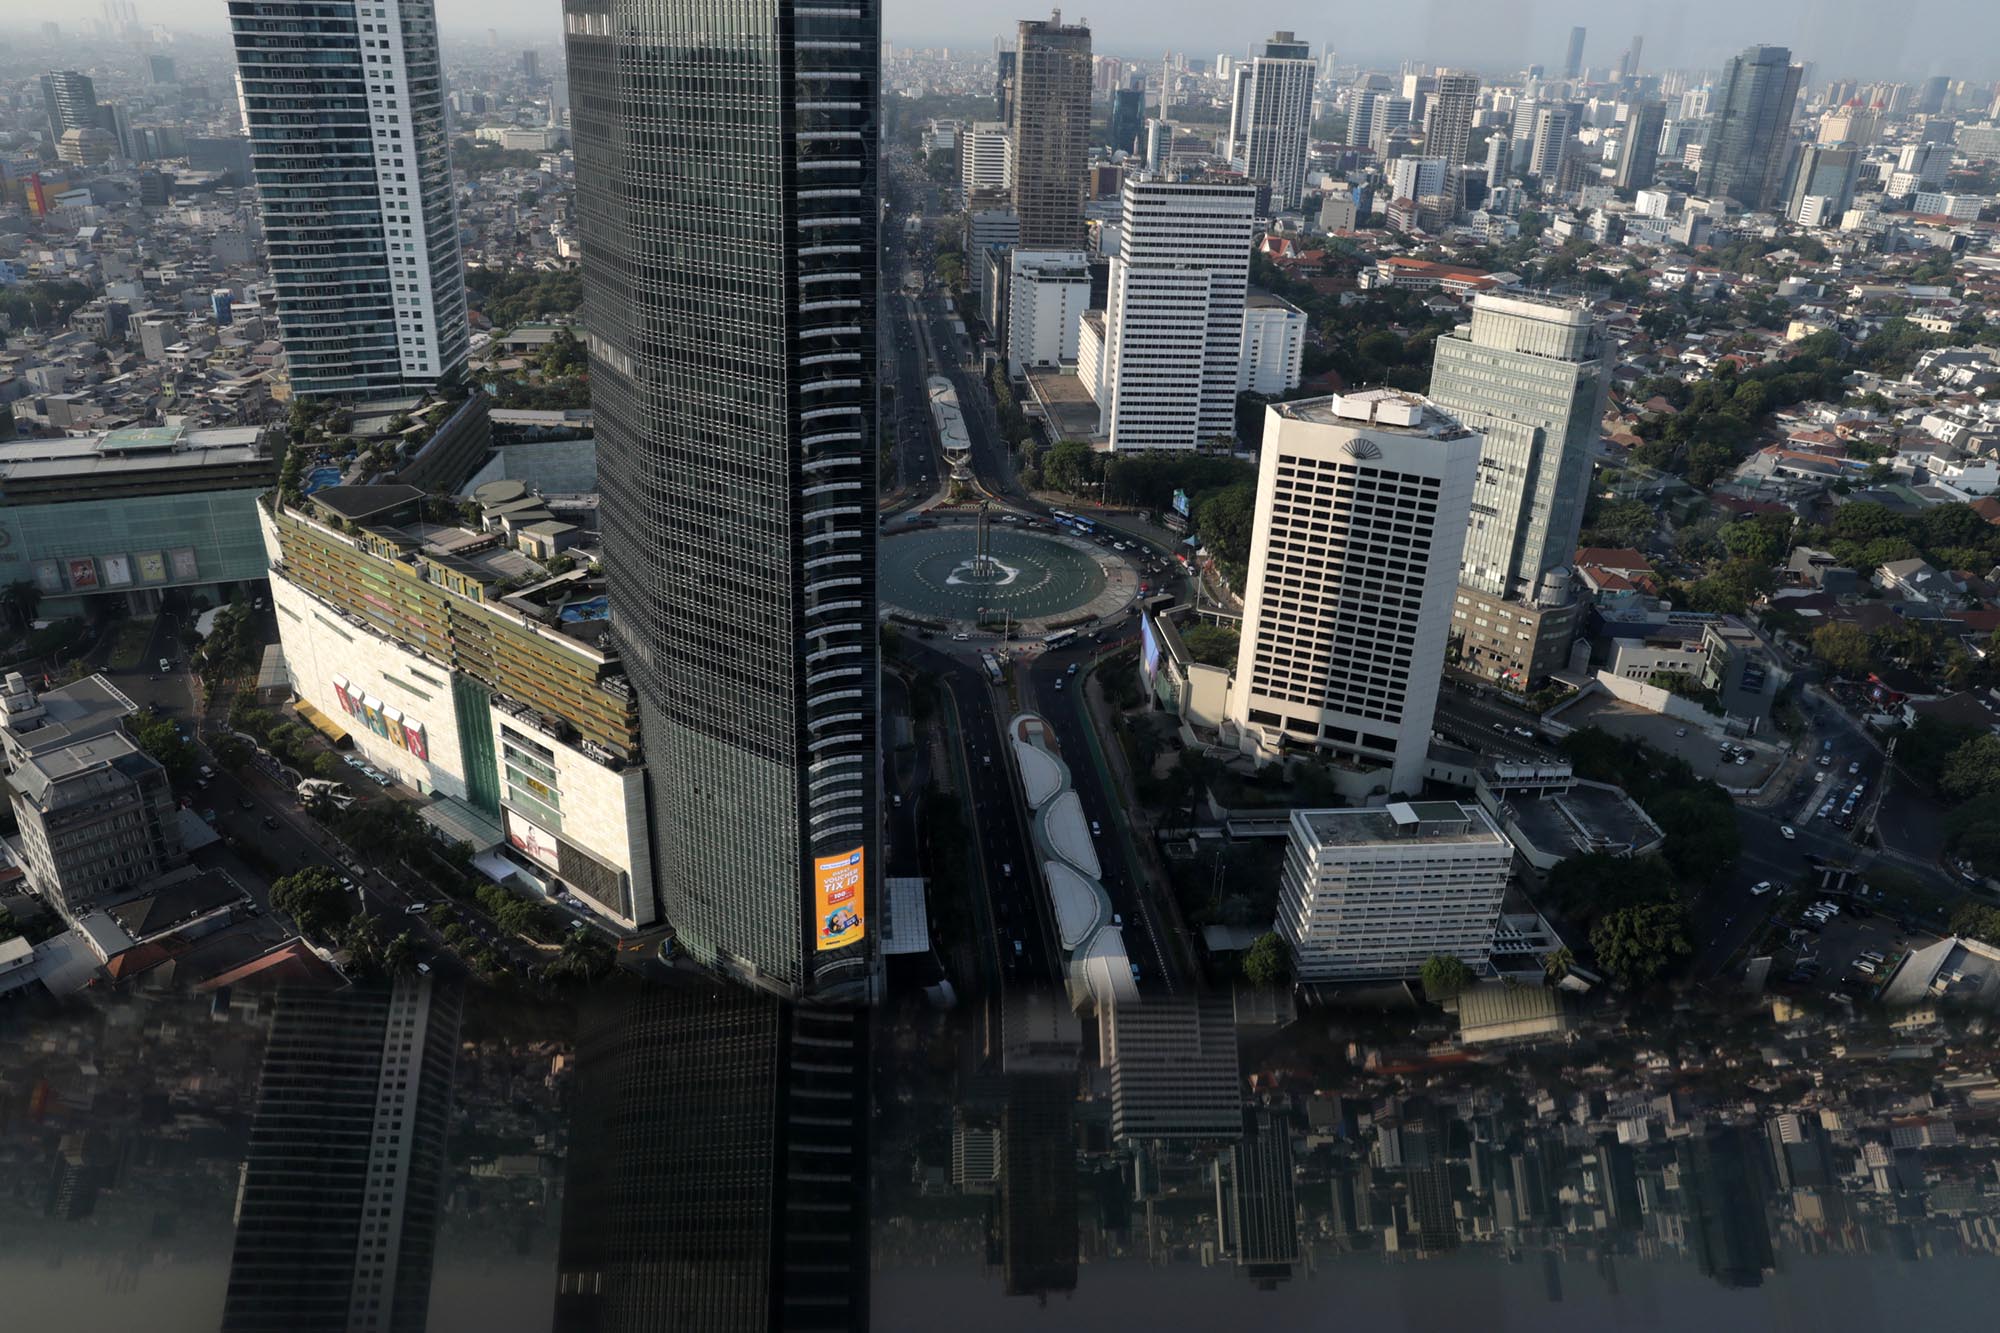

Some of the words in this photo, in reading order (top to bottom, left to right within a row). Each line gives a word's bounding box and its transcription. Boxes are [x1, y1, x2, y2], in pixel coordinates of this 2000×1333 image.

[824, 868, 858, 884] VOUCHER
[825, 881, 843, 892] TIX
[847, 874, 858, 886] ID
